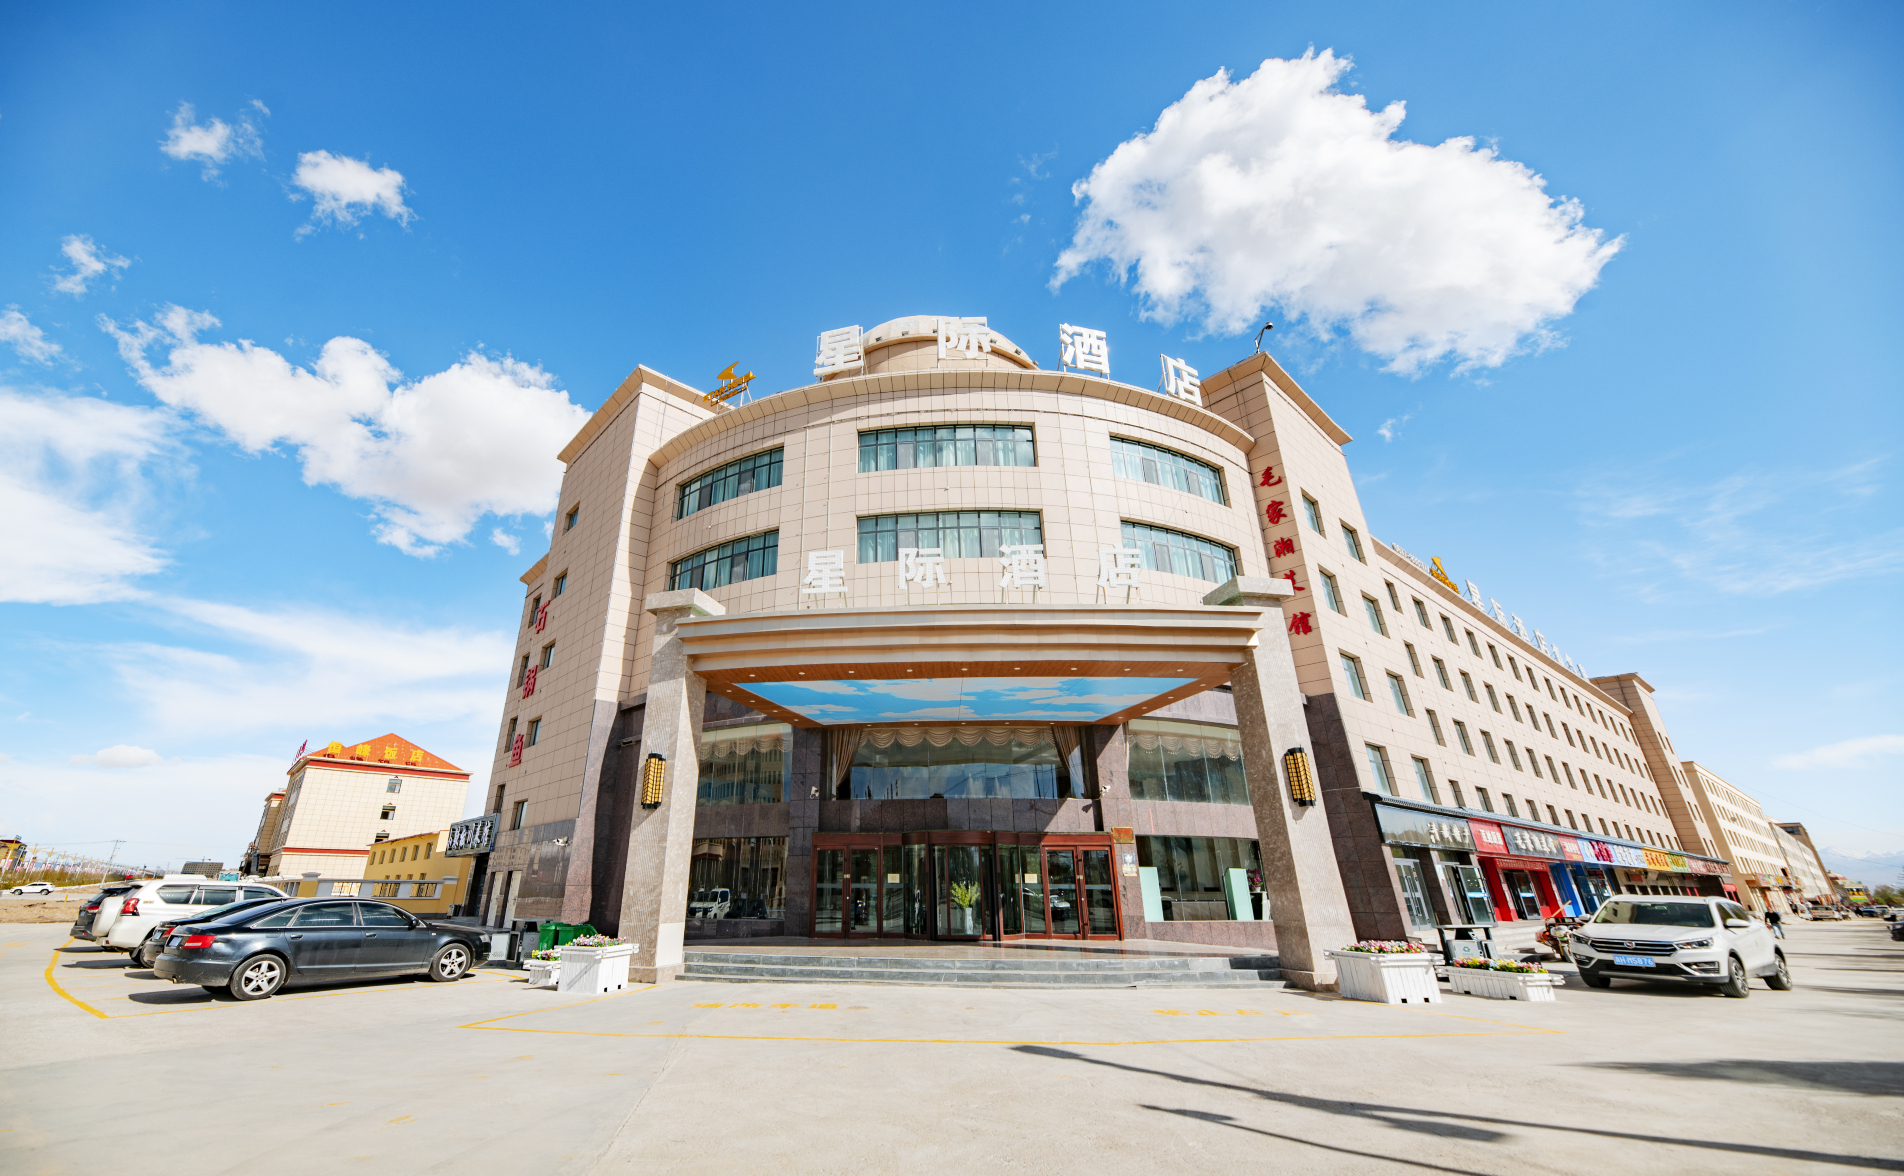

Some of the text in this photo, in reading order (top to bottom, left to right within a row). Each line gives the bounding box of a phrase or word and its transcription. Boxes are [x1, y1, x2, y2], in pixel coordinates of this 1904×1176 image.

[813, 316, 1203, 407] 星际酒店
[802, 544, 1140, 594] 星际酒店
[1260, 466, 1313, 636] 毛家湘菜馆
[508, 600, 551, 768] 石锅鱼
[327, 740, 424, 763] 恒峰饭店
